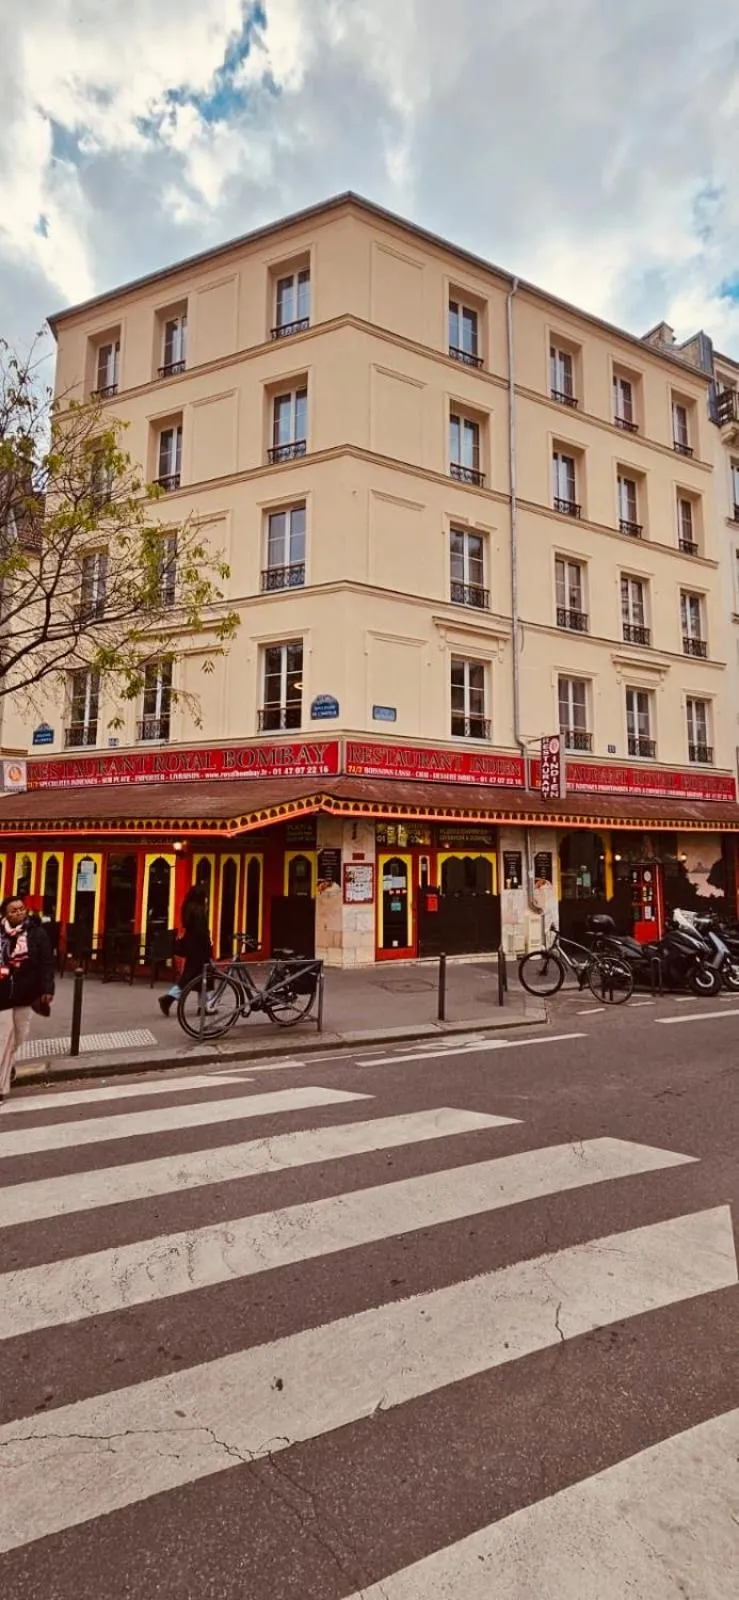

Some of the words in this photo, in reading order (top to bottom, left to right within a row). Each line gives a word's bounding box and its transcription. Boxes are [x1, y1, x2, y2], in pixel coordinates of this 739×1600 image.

[29, 756, 147, 780] RESTAURANT
[152, 752, 217, 772] ROYAL
[223, 744, 330, 768] BOMBAY
[114, 775, 130, 783] PLACE
[273, 768, 282, 776] 01
[284, 767, 293, 775] 47
[296, 767, 305, 775] 07
[306, 766, 317, 774] 22
[319, 765, 329, 773] 16
[348, 744, 464, 771] RESTAURANT
[469, 755, 522, 777] INDIEN
[542, 738, 550, 799] RESTAURANT
[550, 755, 559, 798] INDIEN
